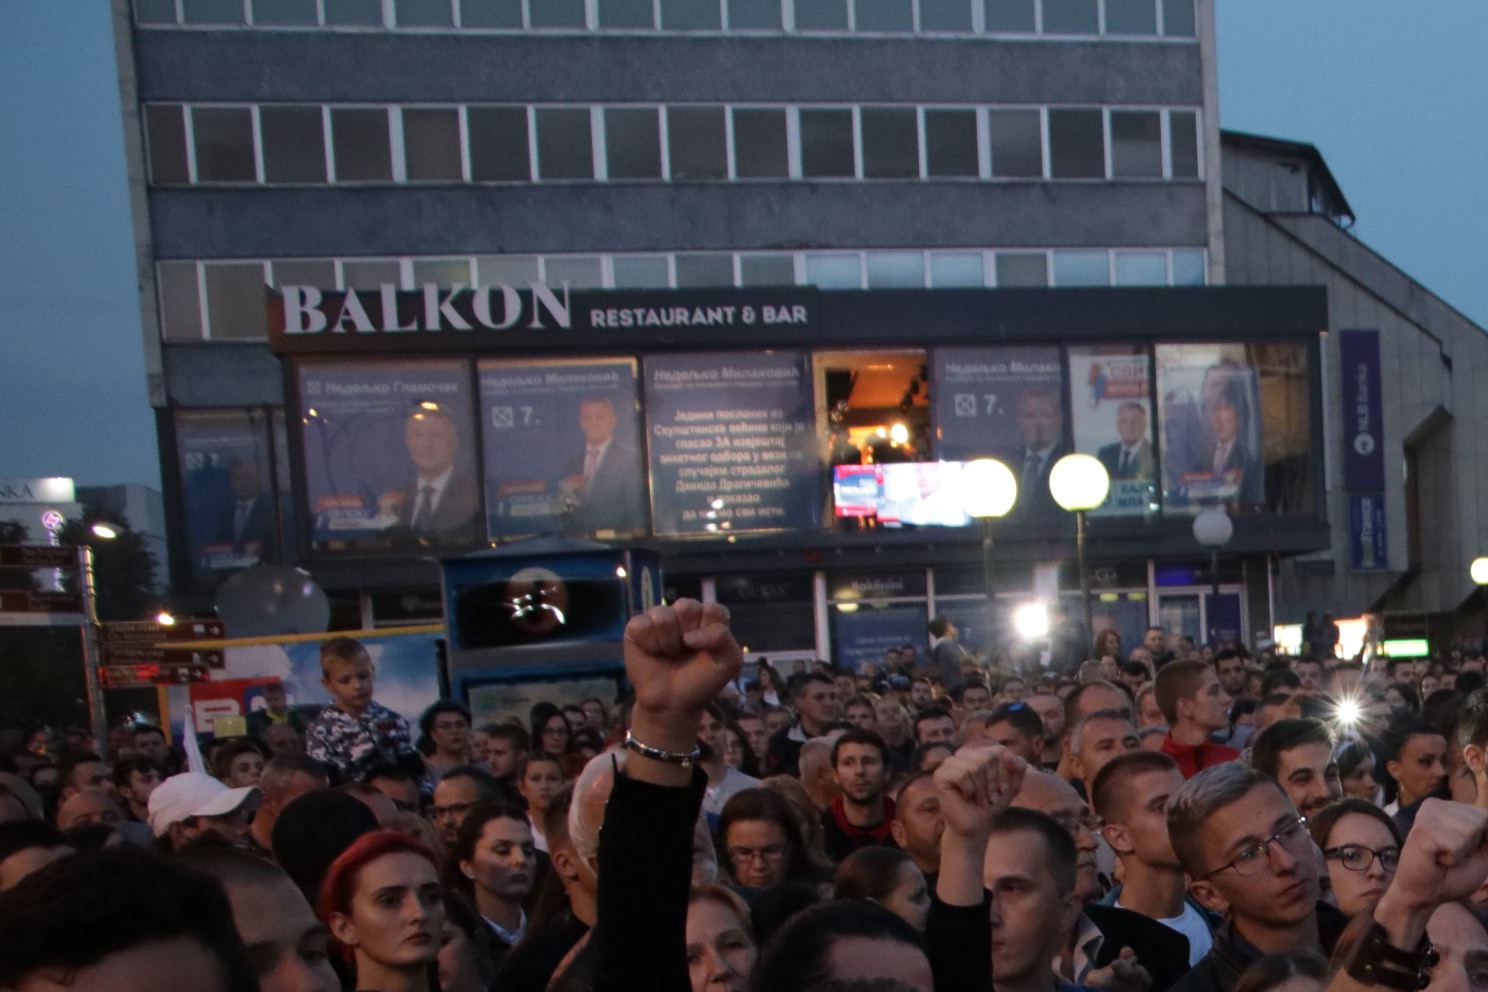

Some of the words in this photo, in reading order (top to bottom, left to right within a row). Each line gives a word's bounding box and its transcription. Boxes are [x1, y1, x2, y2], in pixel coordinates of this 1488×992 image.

[280, 281, 572, 335] BALKON
[592, 307, 736, 327] RESTAURANT
[742, 305, 756, 324] &
[762, 304, 808, 325] BAR
